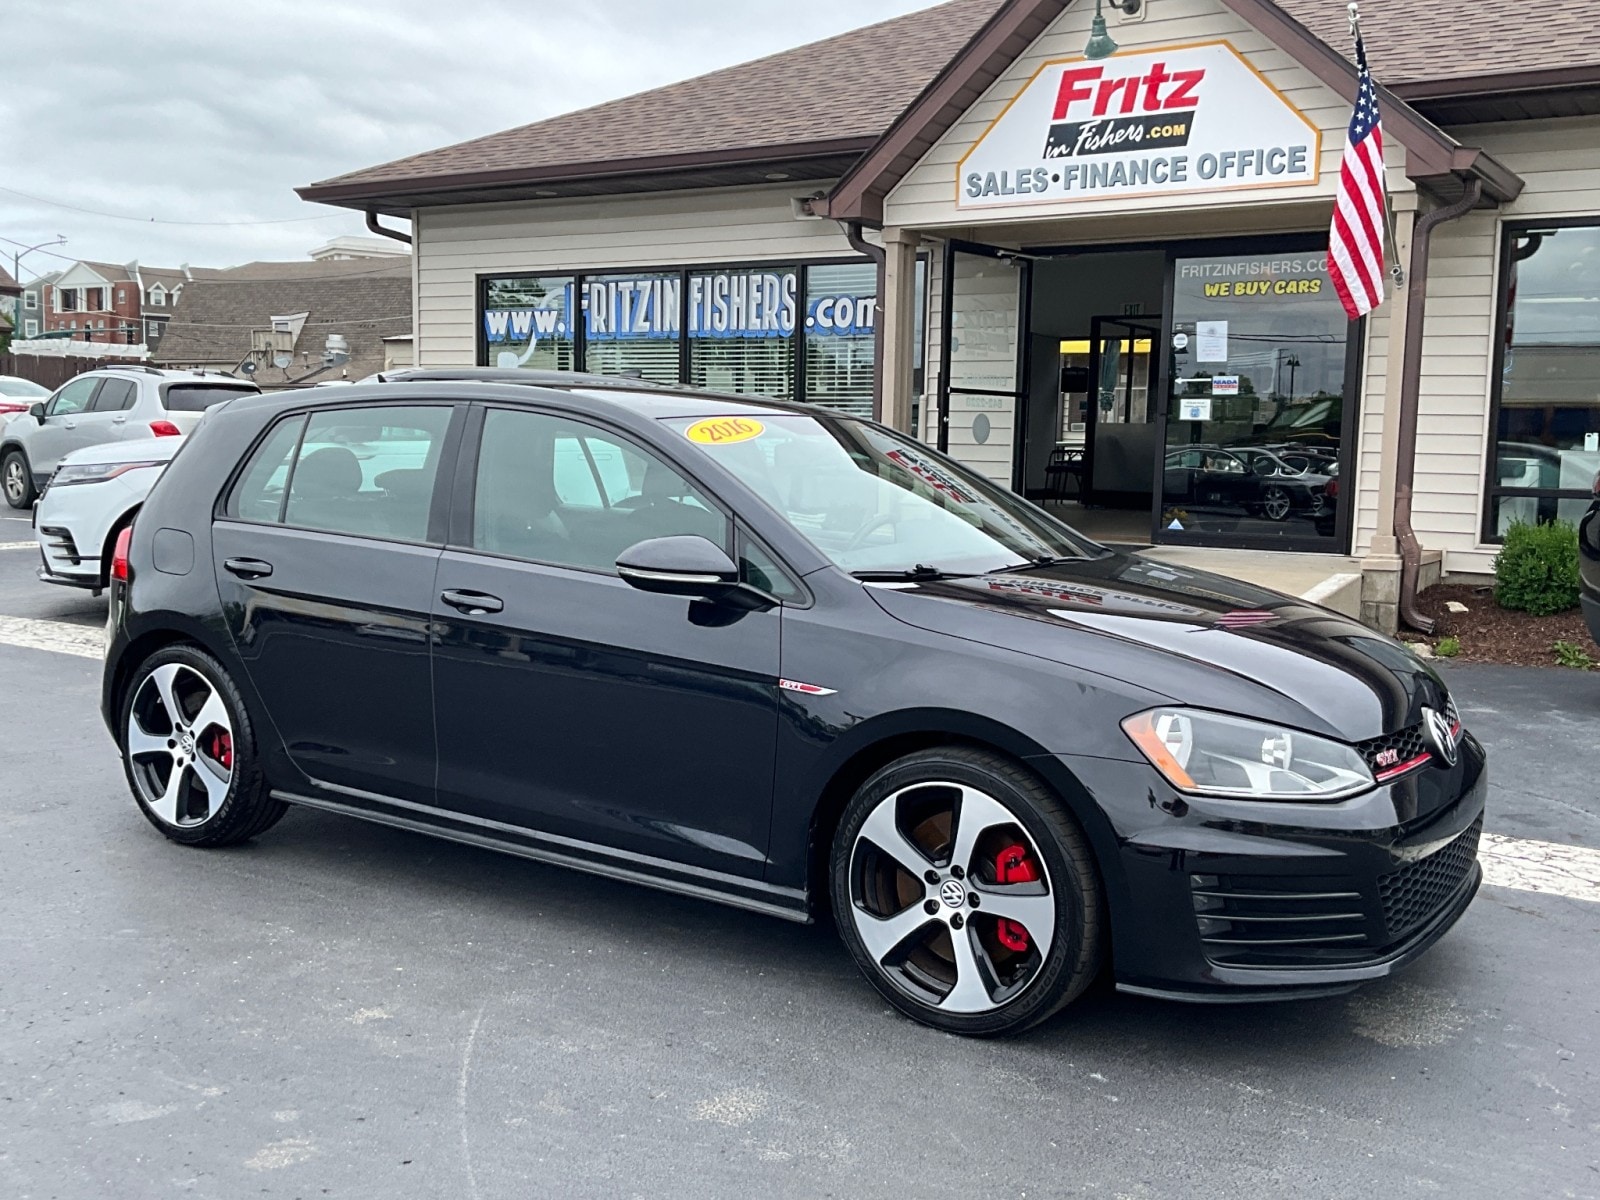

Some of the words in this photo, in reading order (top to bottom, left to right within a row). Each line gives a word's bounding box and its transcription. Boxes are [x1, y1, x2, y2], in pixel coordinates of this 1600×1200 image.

[1052, 62, 1206, 120] Fritz
[1046, 137, 1071, 158] in
[1195, 145, 1307, 180] OFFICE
[1181, 259, 1328, 278] FRITZINFISHERS.CO
[1204, 282, 1231, 297] WE
[1234, 280, 1271, 296] BUY
[1274, 278, 1322, 295] CARS
[700, 418, 753, 442] 2016
[1022, 954, 1063, 1010] COOPER
